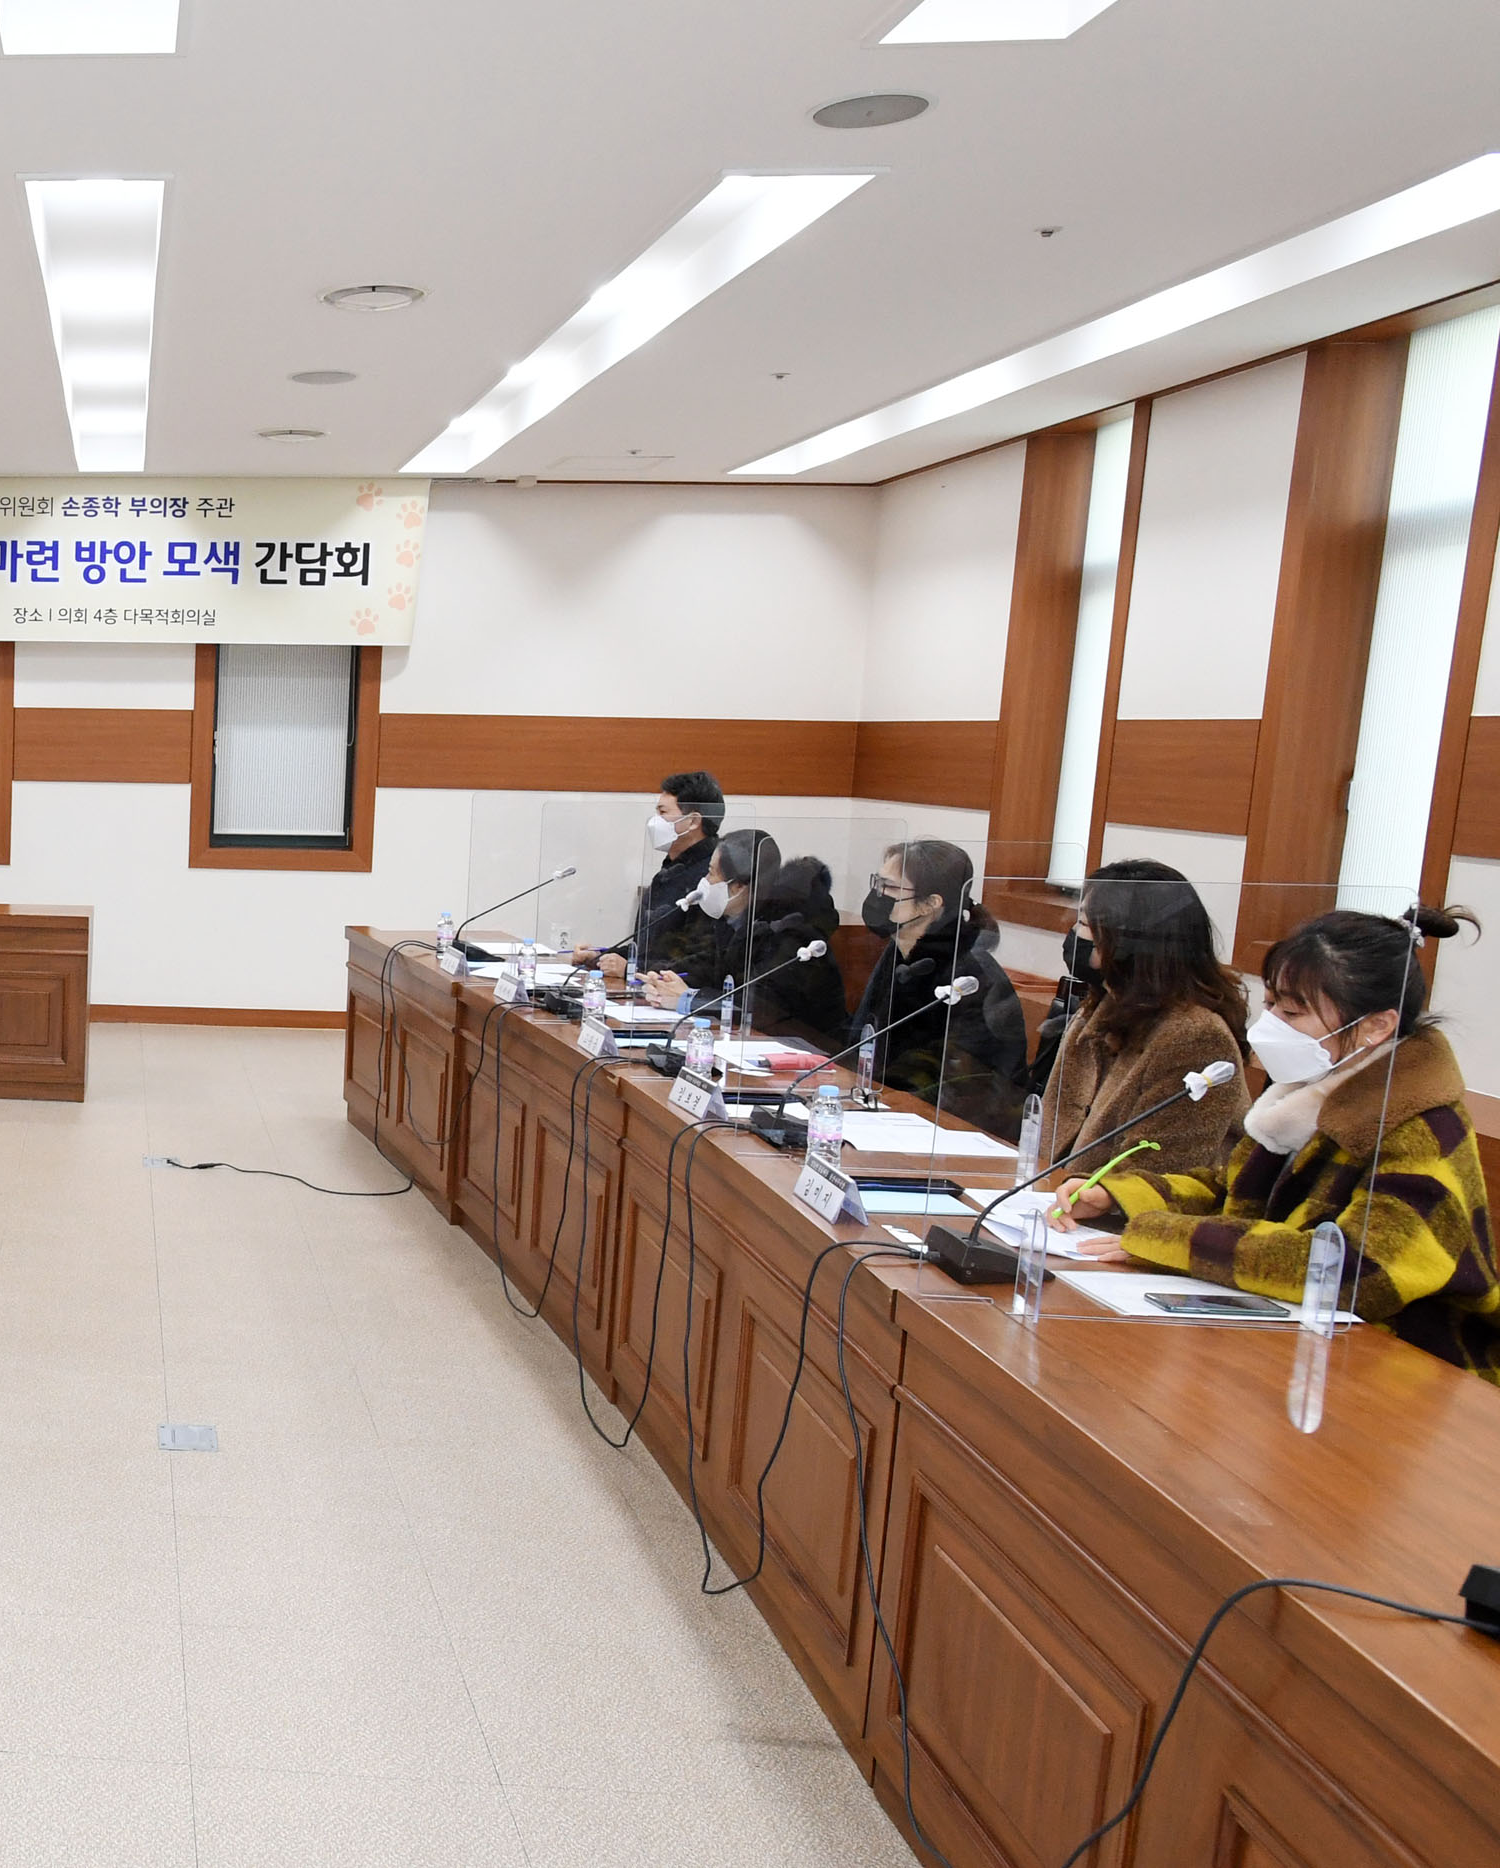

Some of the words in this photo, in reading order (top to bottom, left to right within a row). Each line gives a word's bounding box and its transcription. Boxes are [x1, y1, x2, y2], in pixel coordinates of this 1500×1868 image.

[61, 495, 122, 518] 손종학
[128, 495, 190, 519] 부의장
[195, 497, 236, 519] 주관
[74, 540, 153, 585] 방안
[162, 541, 241, 585] 모색
[254, 541, 371, 587] 간담회
[12, 607, 44, 625] 장소
[57, 607, 88, 625] 의회
[93, 607, 119, 625] 4층
[123, 608, 216, 627] 다목적회의실
